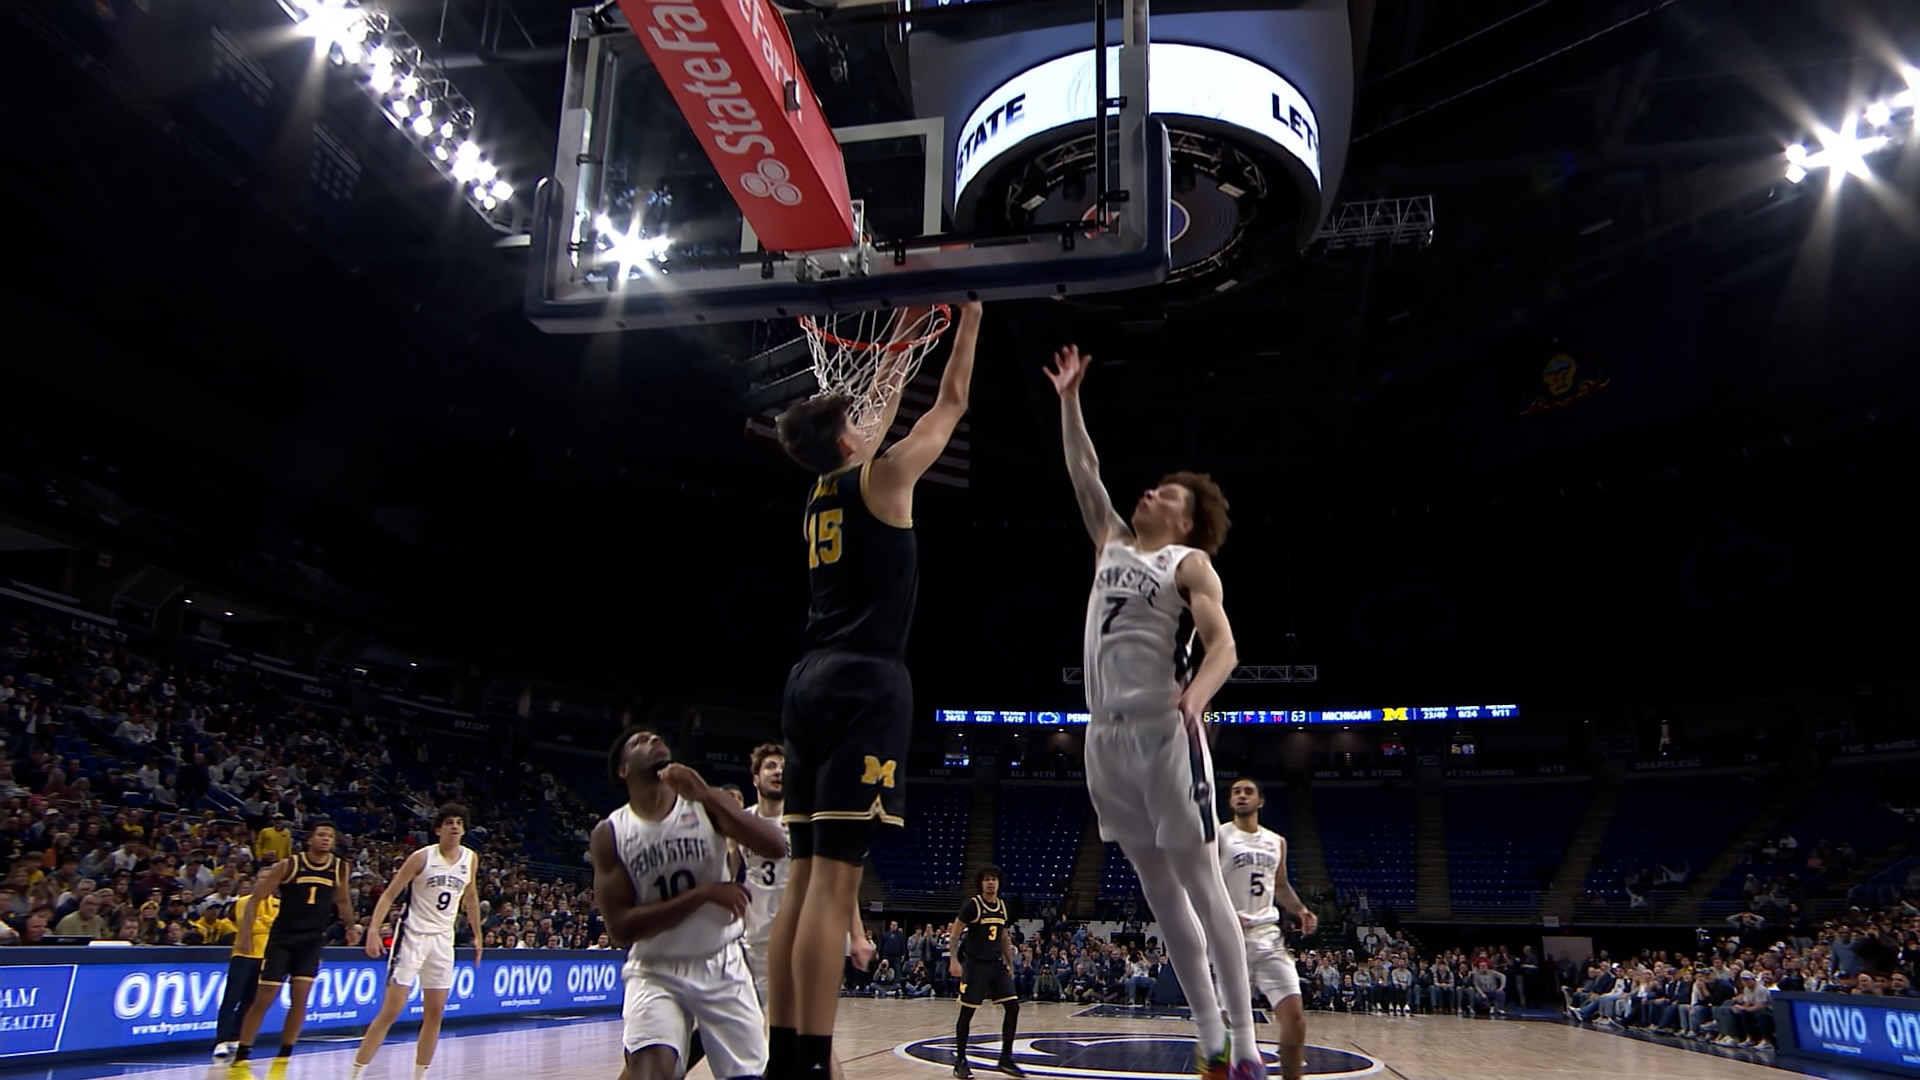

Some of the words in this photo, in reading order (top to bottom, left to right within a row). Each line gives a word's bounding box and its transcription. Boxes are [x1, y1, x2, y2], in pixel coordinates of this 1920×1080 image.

[647, 0, 720, 53] Fa
[956, 92, 1026, 182] STATE
[808, 508, 843, 568] 15
[1101, 596, 1128, 635] 7
[1290, 711, 1306, 722] 63
[1322, 710, 1372, 721] MICHIGAN
[1382, 707, 1409, 721] M
[861, 755, 897, 788] M
[761, 860, 776, 885] 3
[1250, 872, 1265, 896] 5
[306, 886, 318, 904] 1
[435, 891, 452, 911] 9
[988, 925, 998, 940] 3
[493, 964, 552, 997] onvo
[567, 964, 616, 993] onvo
[0, 1013, 57, 1031] EALTH
[1809, 1003, 1868, 1044] onvo
